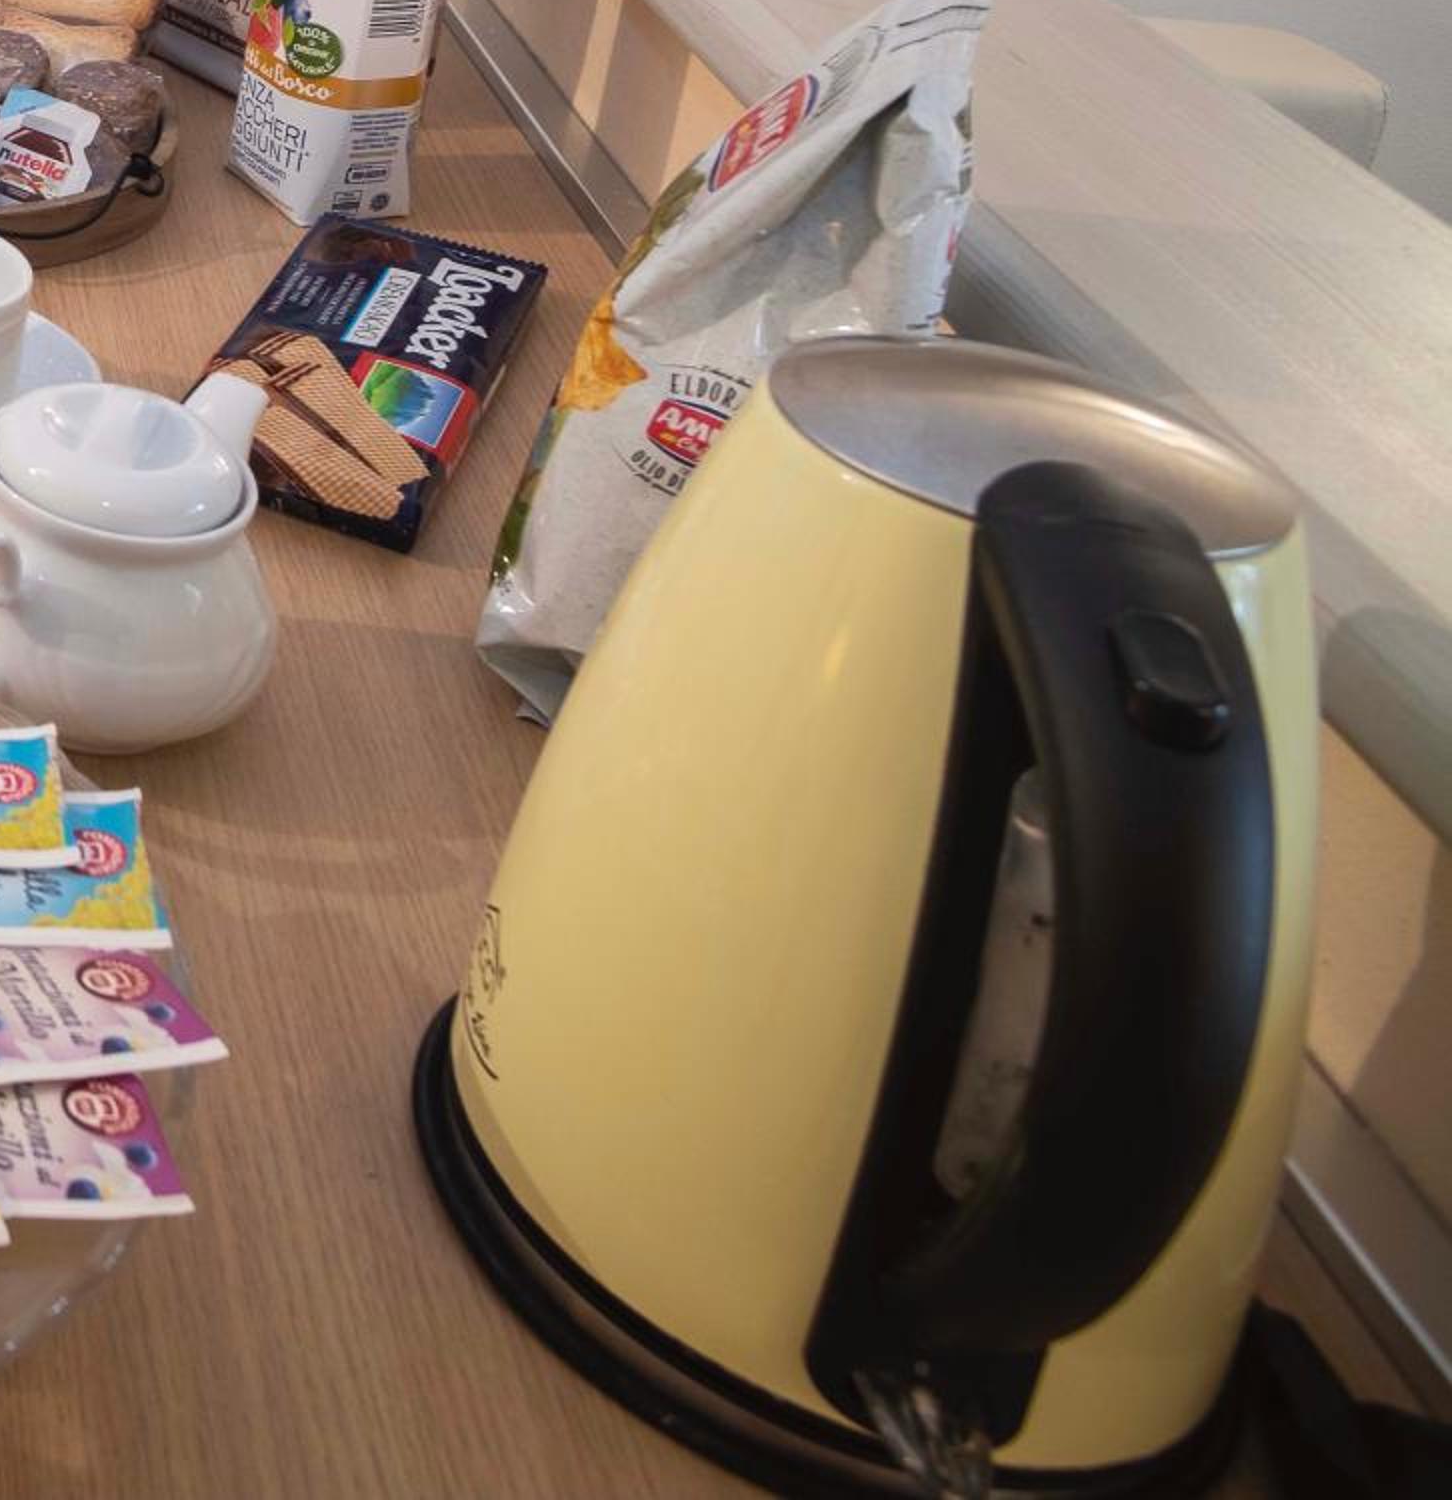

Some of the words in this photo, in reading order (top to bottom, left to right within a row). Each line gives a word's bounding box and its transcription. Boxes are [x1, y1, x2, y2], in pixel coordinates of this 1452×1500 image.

[245, 73, 276, 112] NZA
[273, 63, 331, 99] Bosco
[0, 147, 67, 181] nutella
[404, 257, 526, 370] Loacker
[669, 372, 741, 412] ELDOR
[630, 450, 667, 480] OLIO
[667, 473, 688, 493] DI
